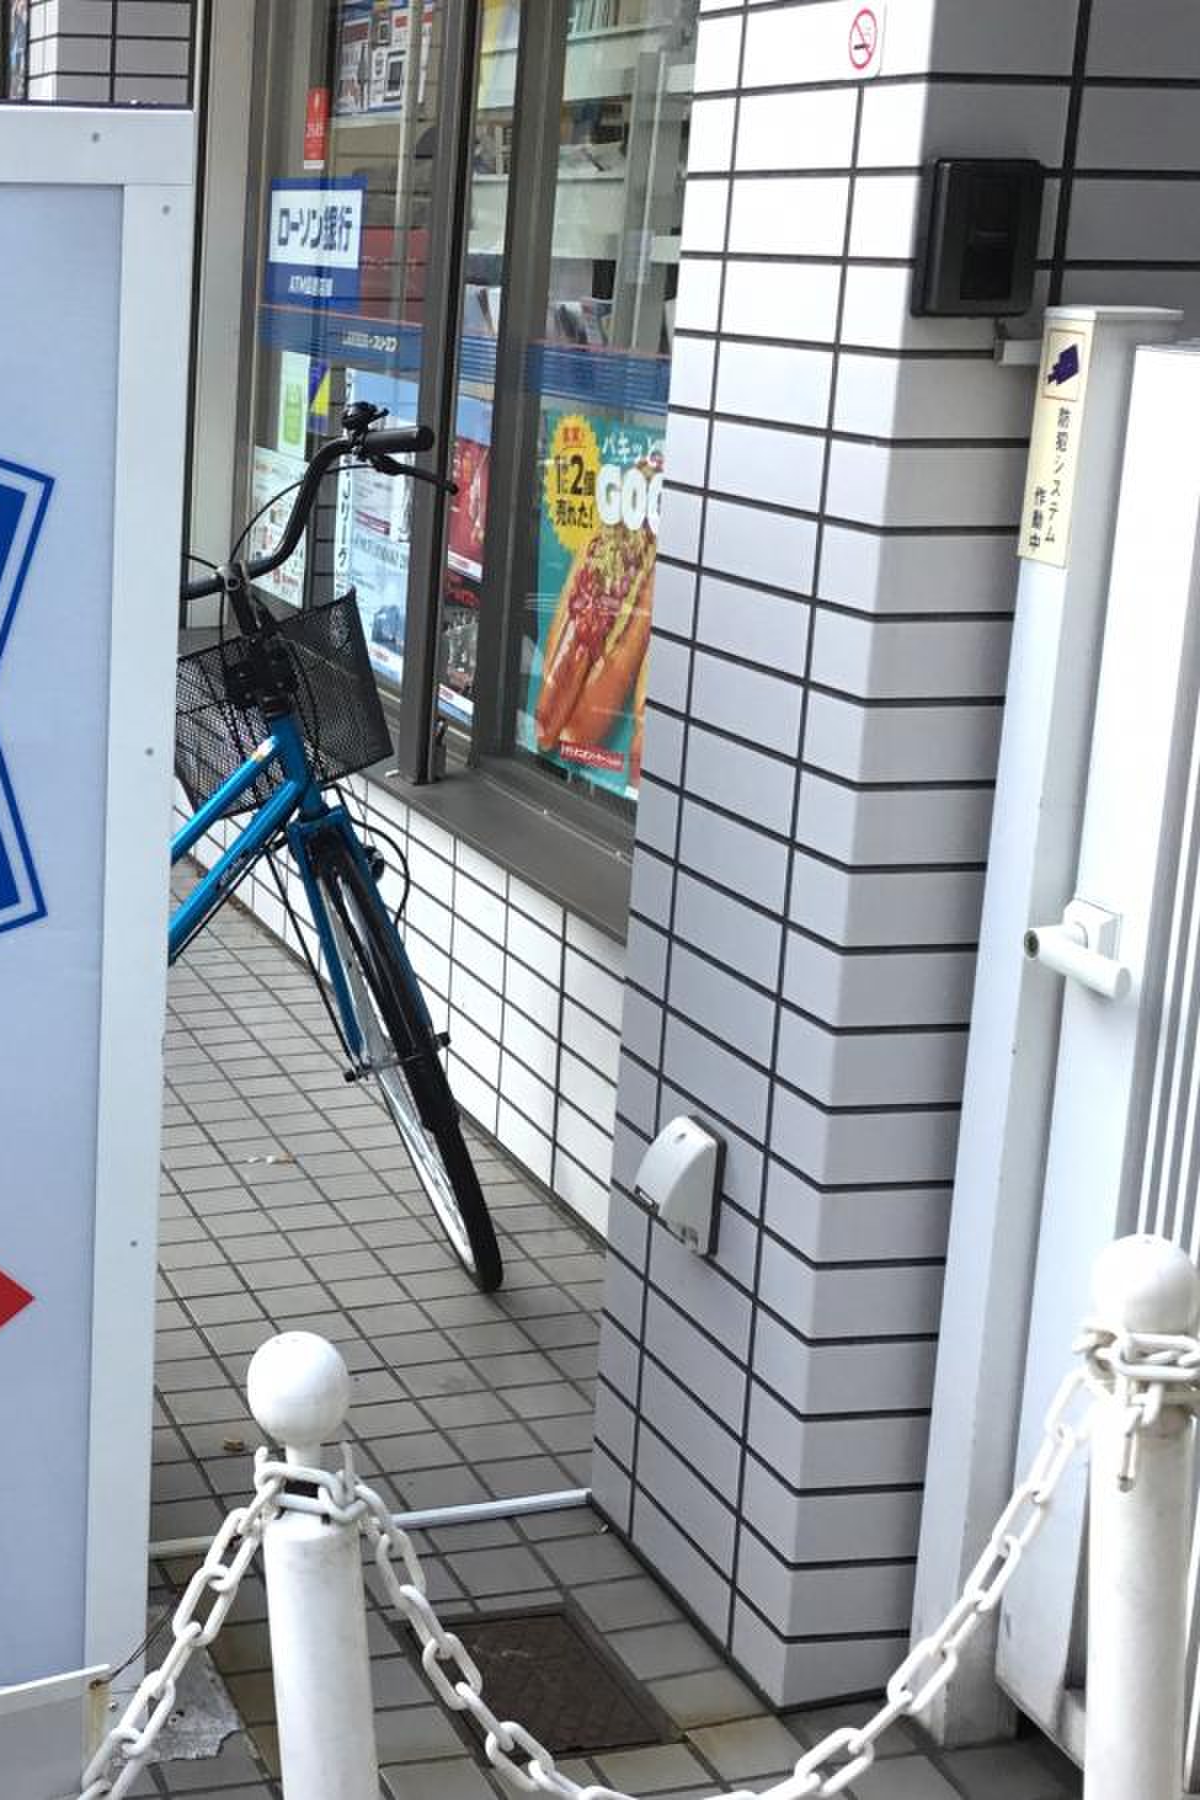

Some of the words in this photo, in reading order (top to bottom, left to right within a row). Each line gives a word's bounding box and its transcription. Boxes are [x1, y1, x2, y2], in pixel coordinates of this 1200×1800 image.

[277, 205, 353, 253] ローソン銀行
